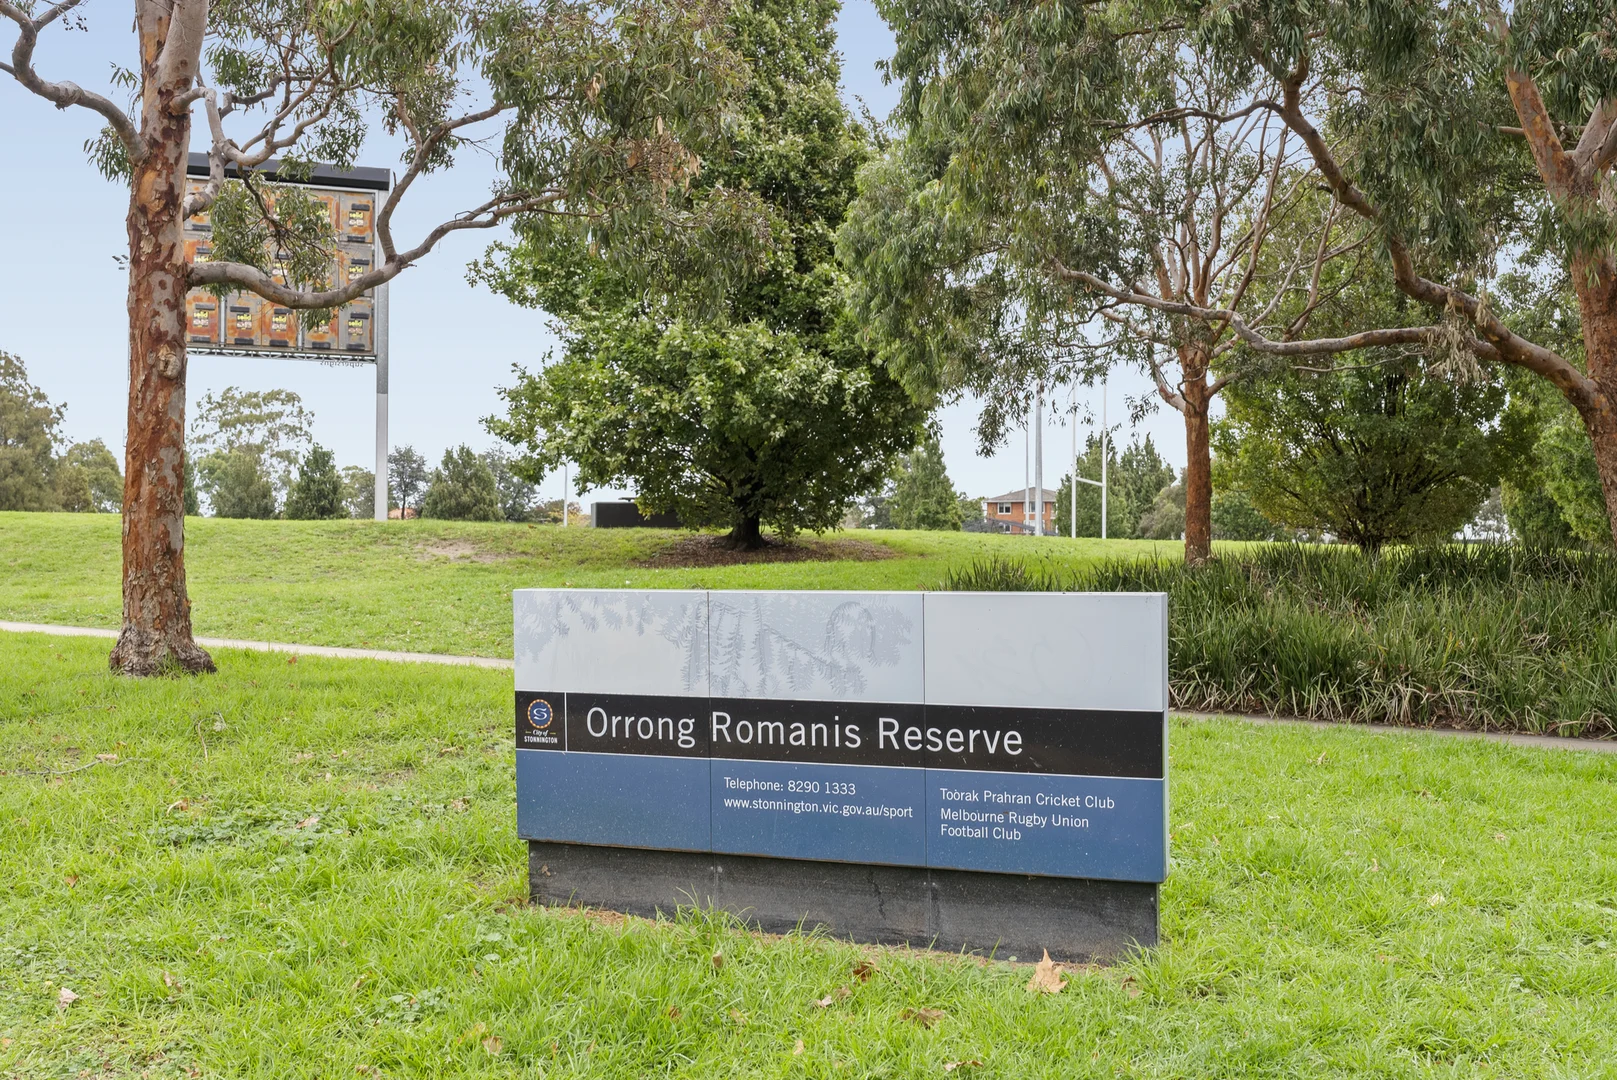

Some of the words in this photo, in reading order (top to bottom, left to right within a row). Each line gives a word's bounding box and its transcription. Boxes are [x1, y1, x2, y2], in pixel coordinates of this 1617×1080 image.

[586, 707, 696, 749] Orrong
[711, 711, 861, 749] Romanis
[878, 717, 1023, 756] Reserve
[723, 776, 784, 793] Telephone:
[787, 779, 820, 794] 8290
[823, 781, 856, 796] 1333
[723, 798, 913, 819] www.stonnington.vic.gov.au/sport
[939, 787, 979, 803] Toorak
[983, 789, 1032, 806] Prahran
[1035, 792, 1081, 808] Cricket
[1084, 795, 1116, 809] Club
[940, 808, 1004, 823] Melbourne
[1008, 811, 1048, 829] Rugby
[1051, 813, 1089, 828] Union
[940, 824, 988, 839] Football
[992, 827, 1022, 840] Club
